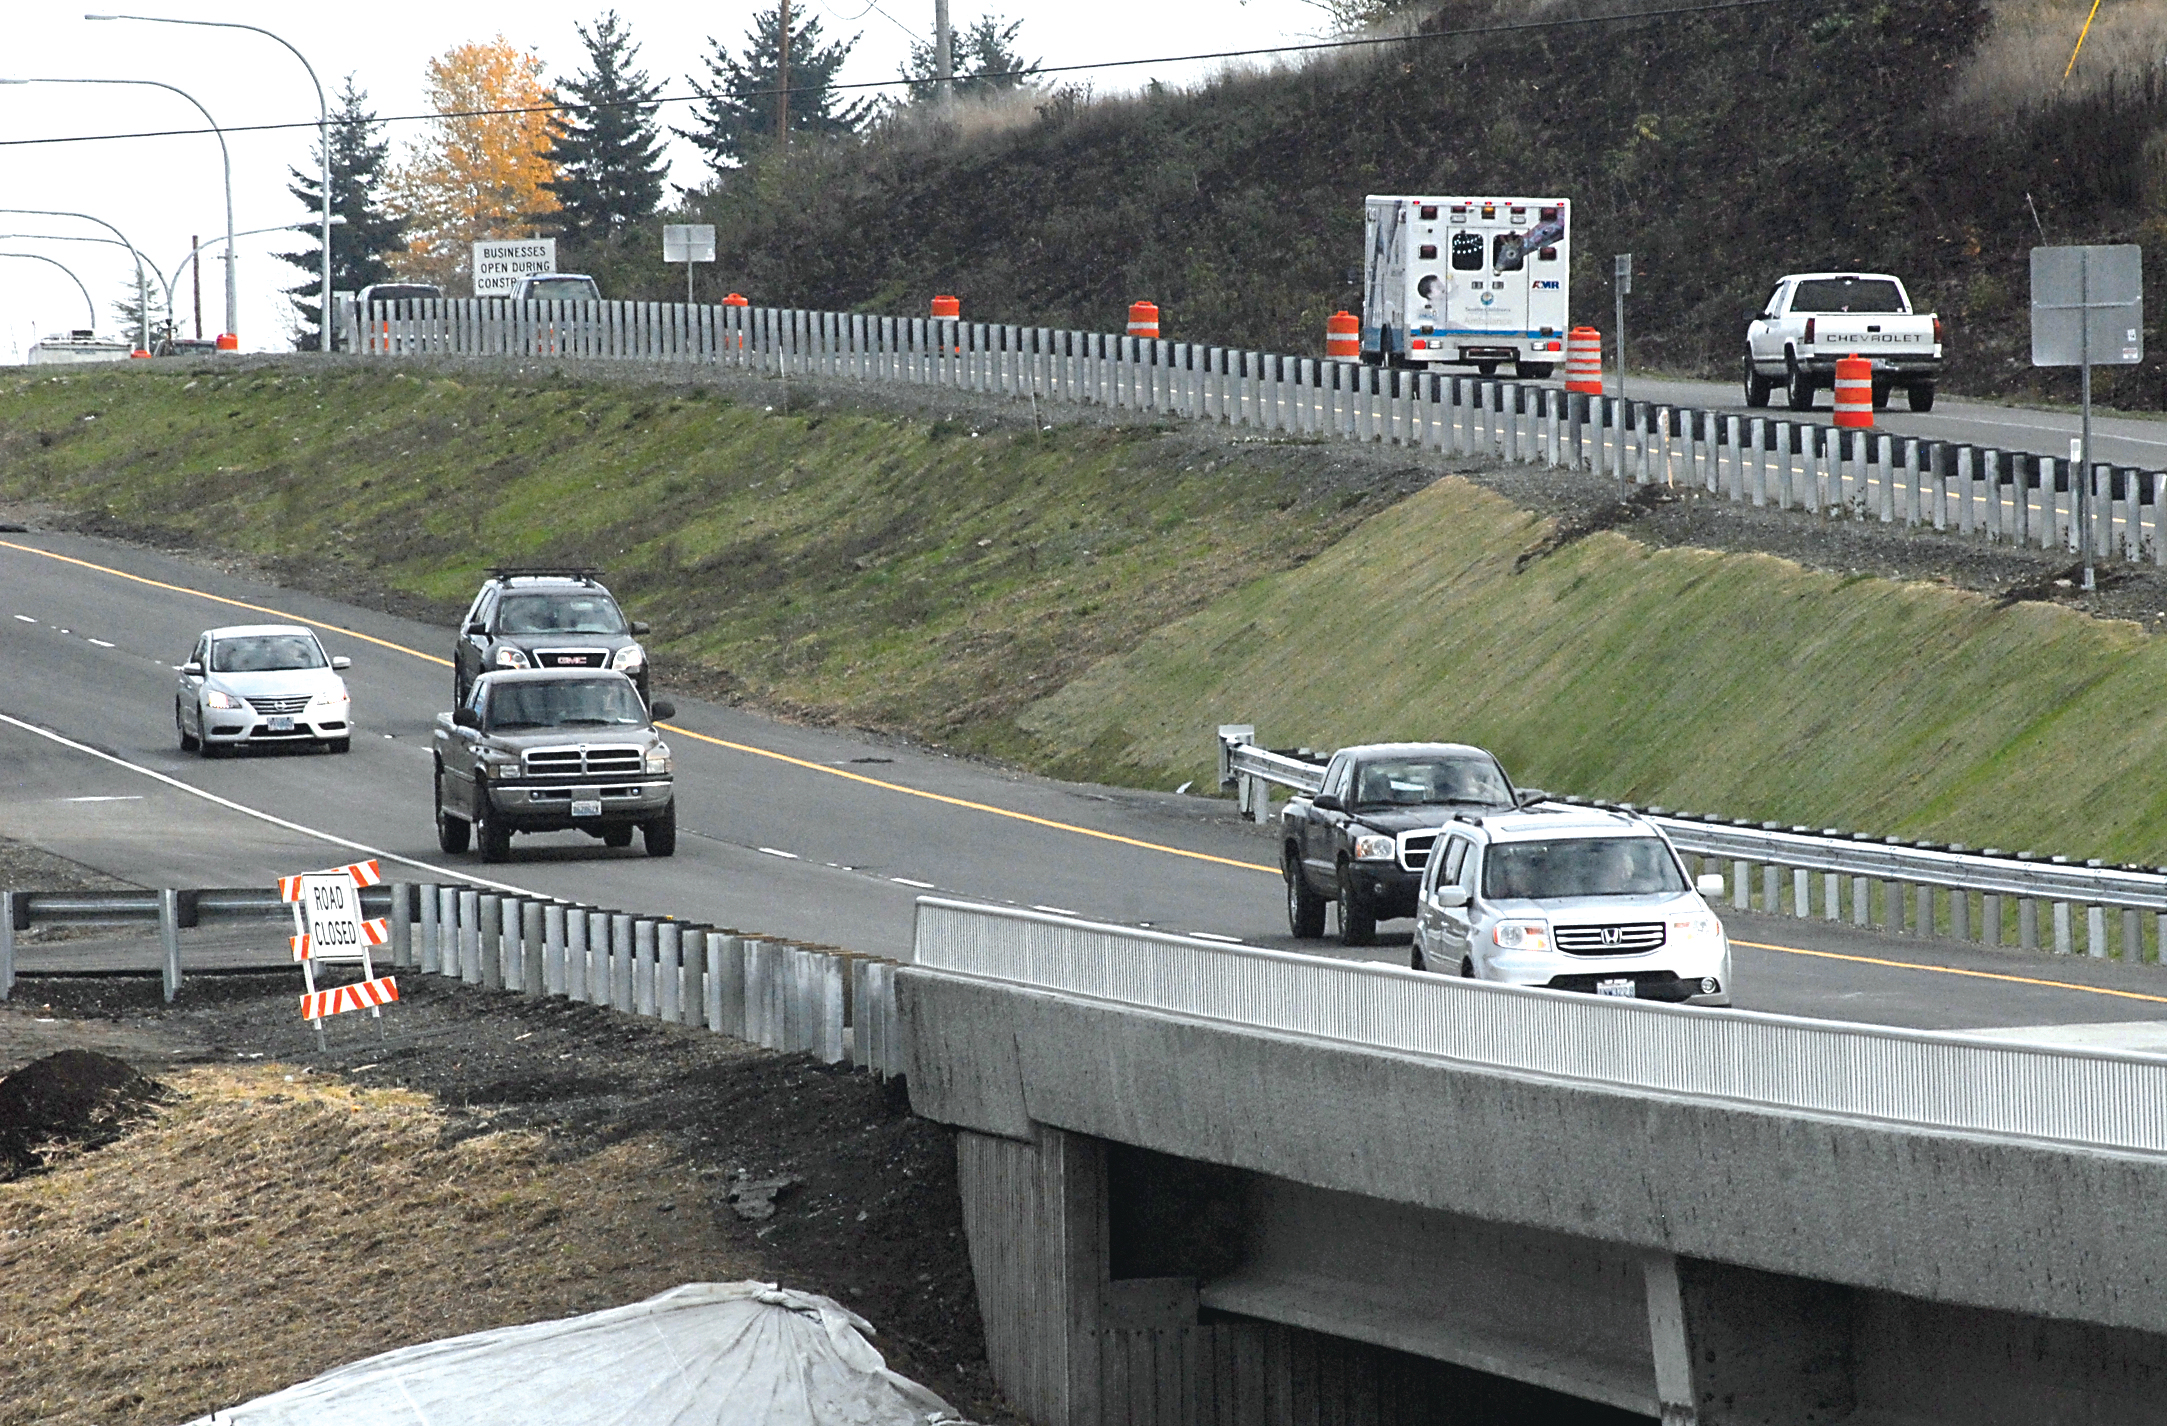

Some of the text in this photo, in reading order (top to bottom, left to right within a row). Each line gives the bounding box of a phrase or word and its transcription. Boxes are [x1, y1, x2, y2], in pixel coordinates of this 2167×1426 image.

[484, 246, 546, 258] BUSINESSES
[481, 261, 550, 273] OPEN DURING
[478, 277, 518, 288] CONSTR
[1827, 334, 1922, 342] CHEVROLET
[557, 656, 587, 664] GMC
[314, 886, 344, 910] ROAD
[314, 921, 357, 945] CLOSED
